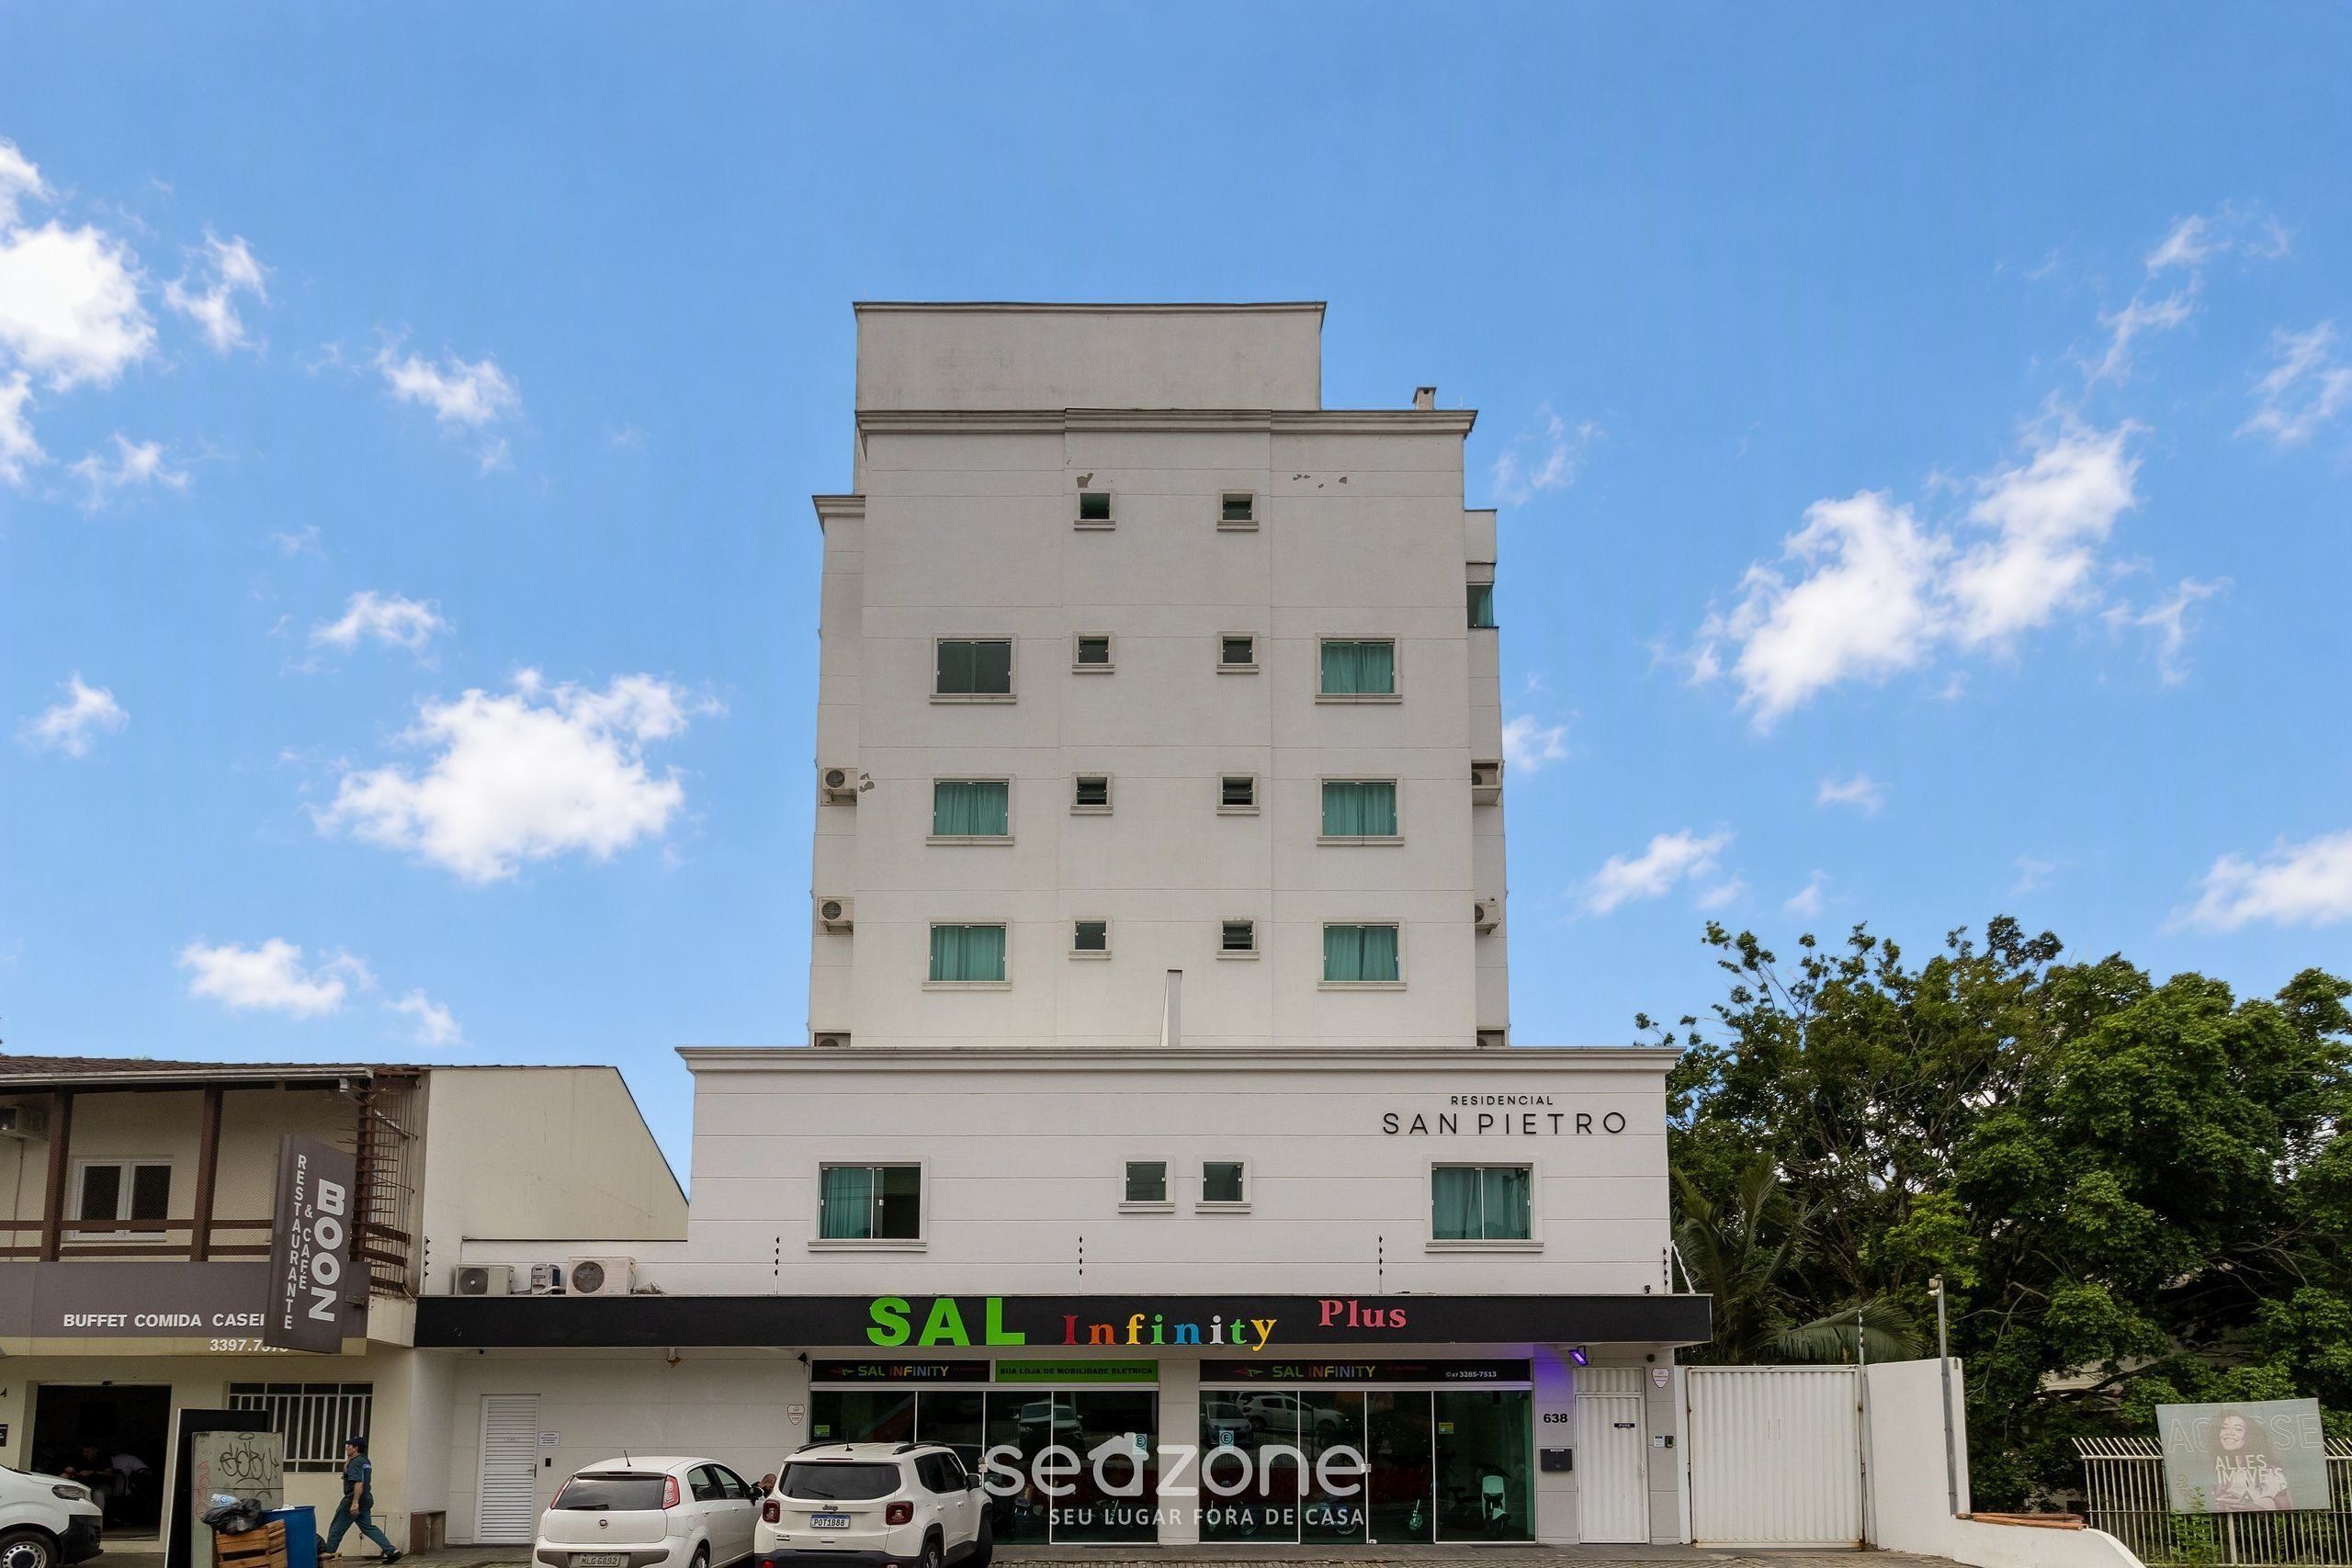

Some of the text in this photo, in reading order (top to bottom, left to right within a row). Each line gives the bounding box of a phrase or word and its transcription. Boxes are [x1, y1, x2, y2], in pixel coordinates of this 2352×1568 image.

[1451, 1095, 1554, 1106] RESIDENCIAL
[1382, 1111, 1626, 1134] SAN PIETRO
[284, 1154, 307, 1330] RESTAURANTE
[63, 1314, 128, 1327] BUFFET
[134, 1314, 202, 1327] COMIDA
[866, 1297, 1408, 1351] SAL Infinity Plus
[209, 1338, 288, 1352] 3397.7
[858, 1366, 886, 1376] SAL
[889, 1366, 949, 1376] INFINITY
[1272, 1366, 1304, 1378] SAL
[1308, 1366, 1376, 1378] INFINITY
[1543, 1413, 1568, 1424] 638
[2215, 1454, 2267, 1471] ALLES
